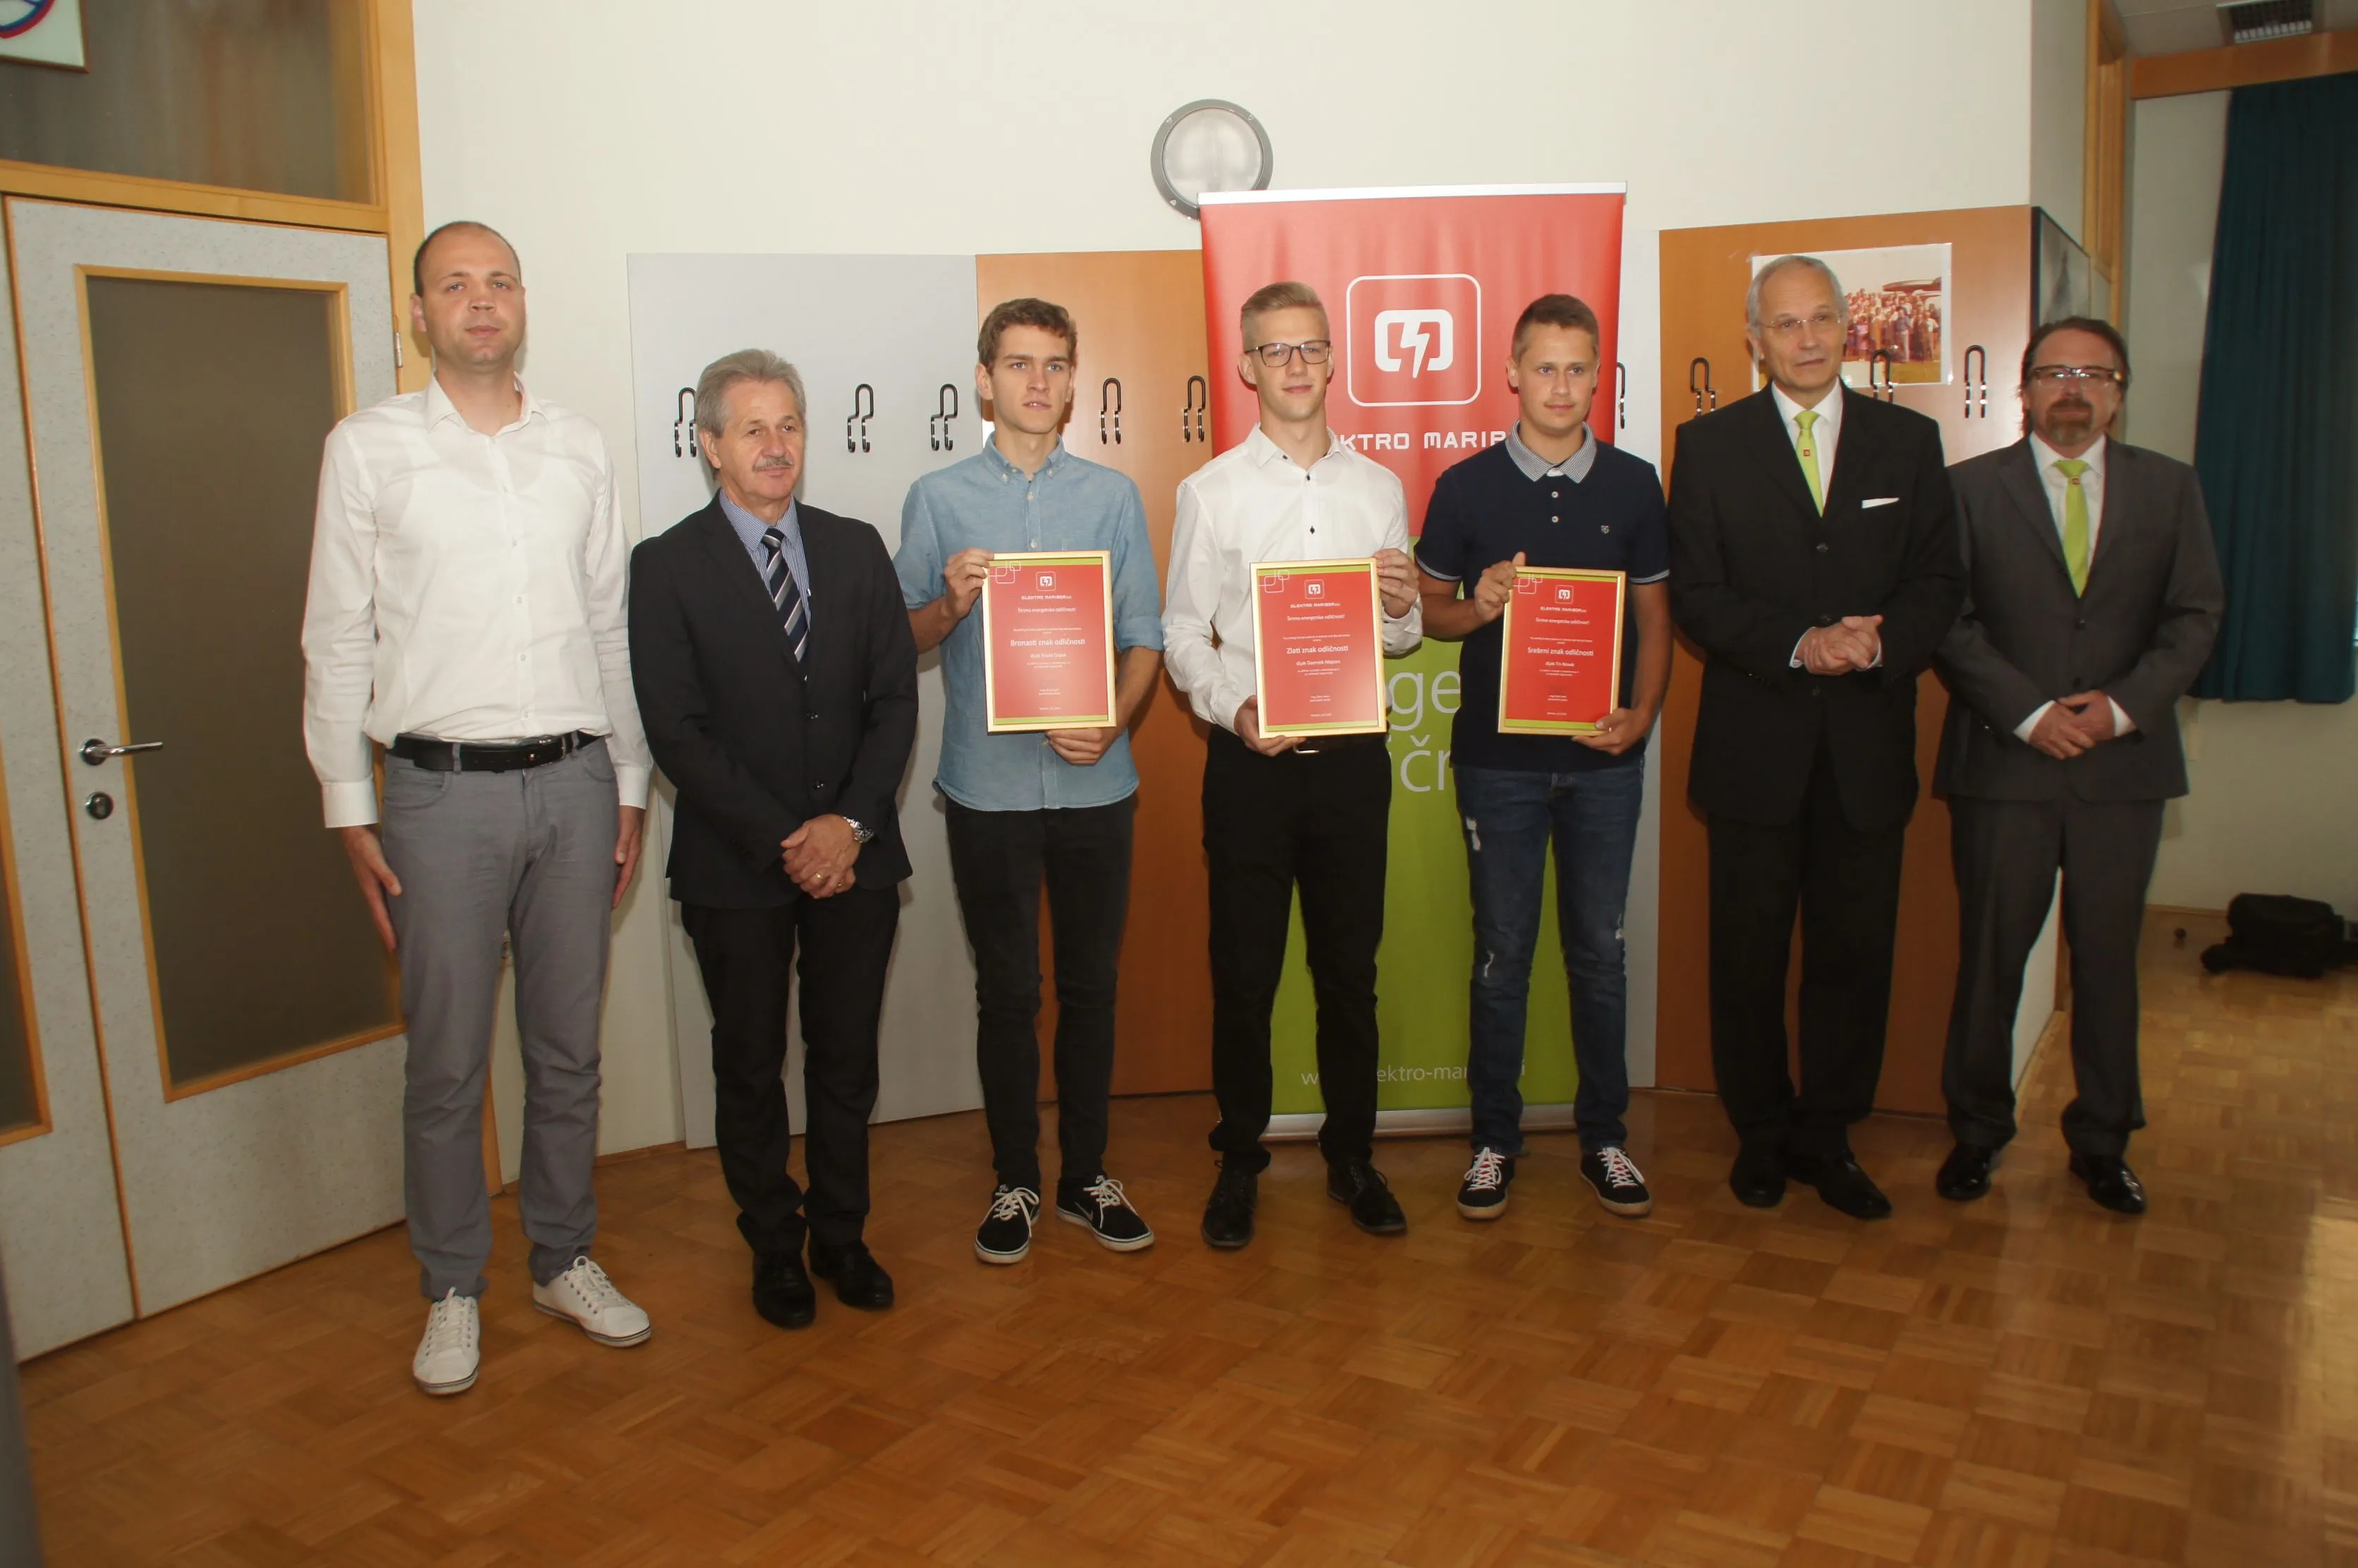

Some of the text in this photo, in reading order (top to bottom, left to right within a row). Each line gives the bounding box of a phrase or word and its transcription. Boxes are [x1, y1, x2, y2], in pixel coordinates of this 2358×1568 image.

[1340, 430, 1507, 451] KTRO MARI
[1038, 638, 1053, 647] znak
[1053, 637, 1086, 646] odličnosti
[1317, 644, 1349, 653] odličnosti
